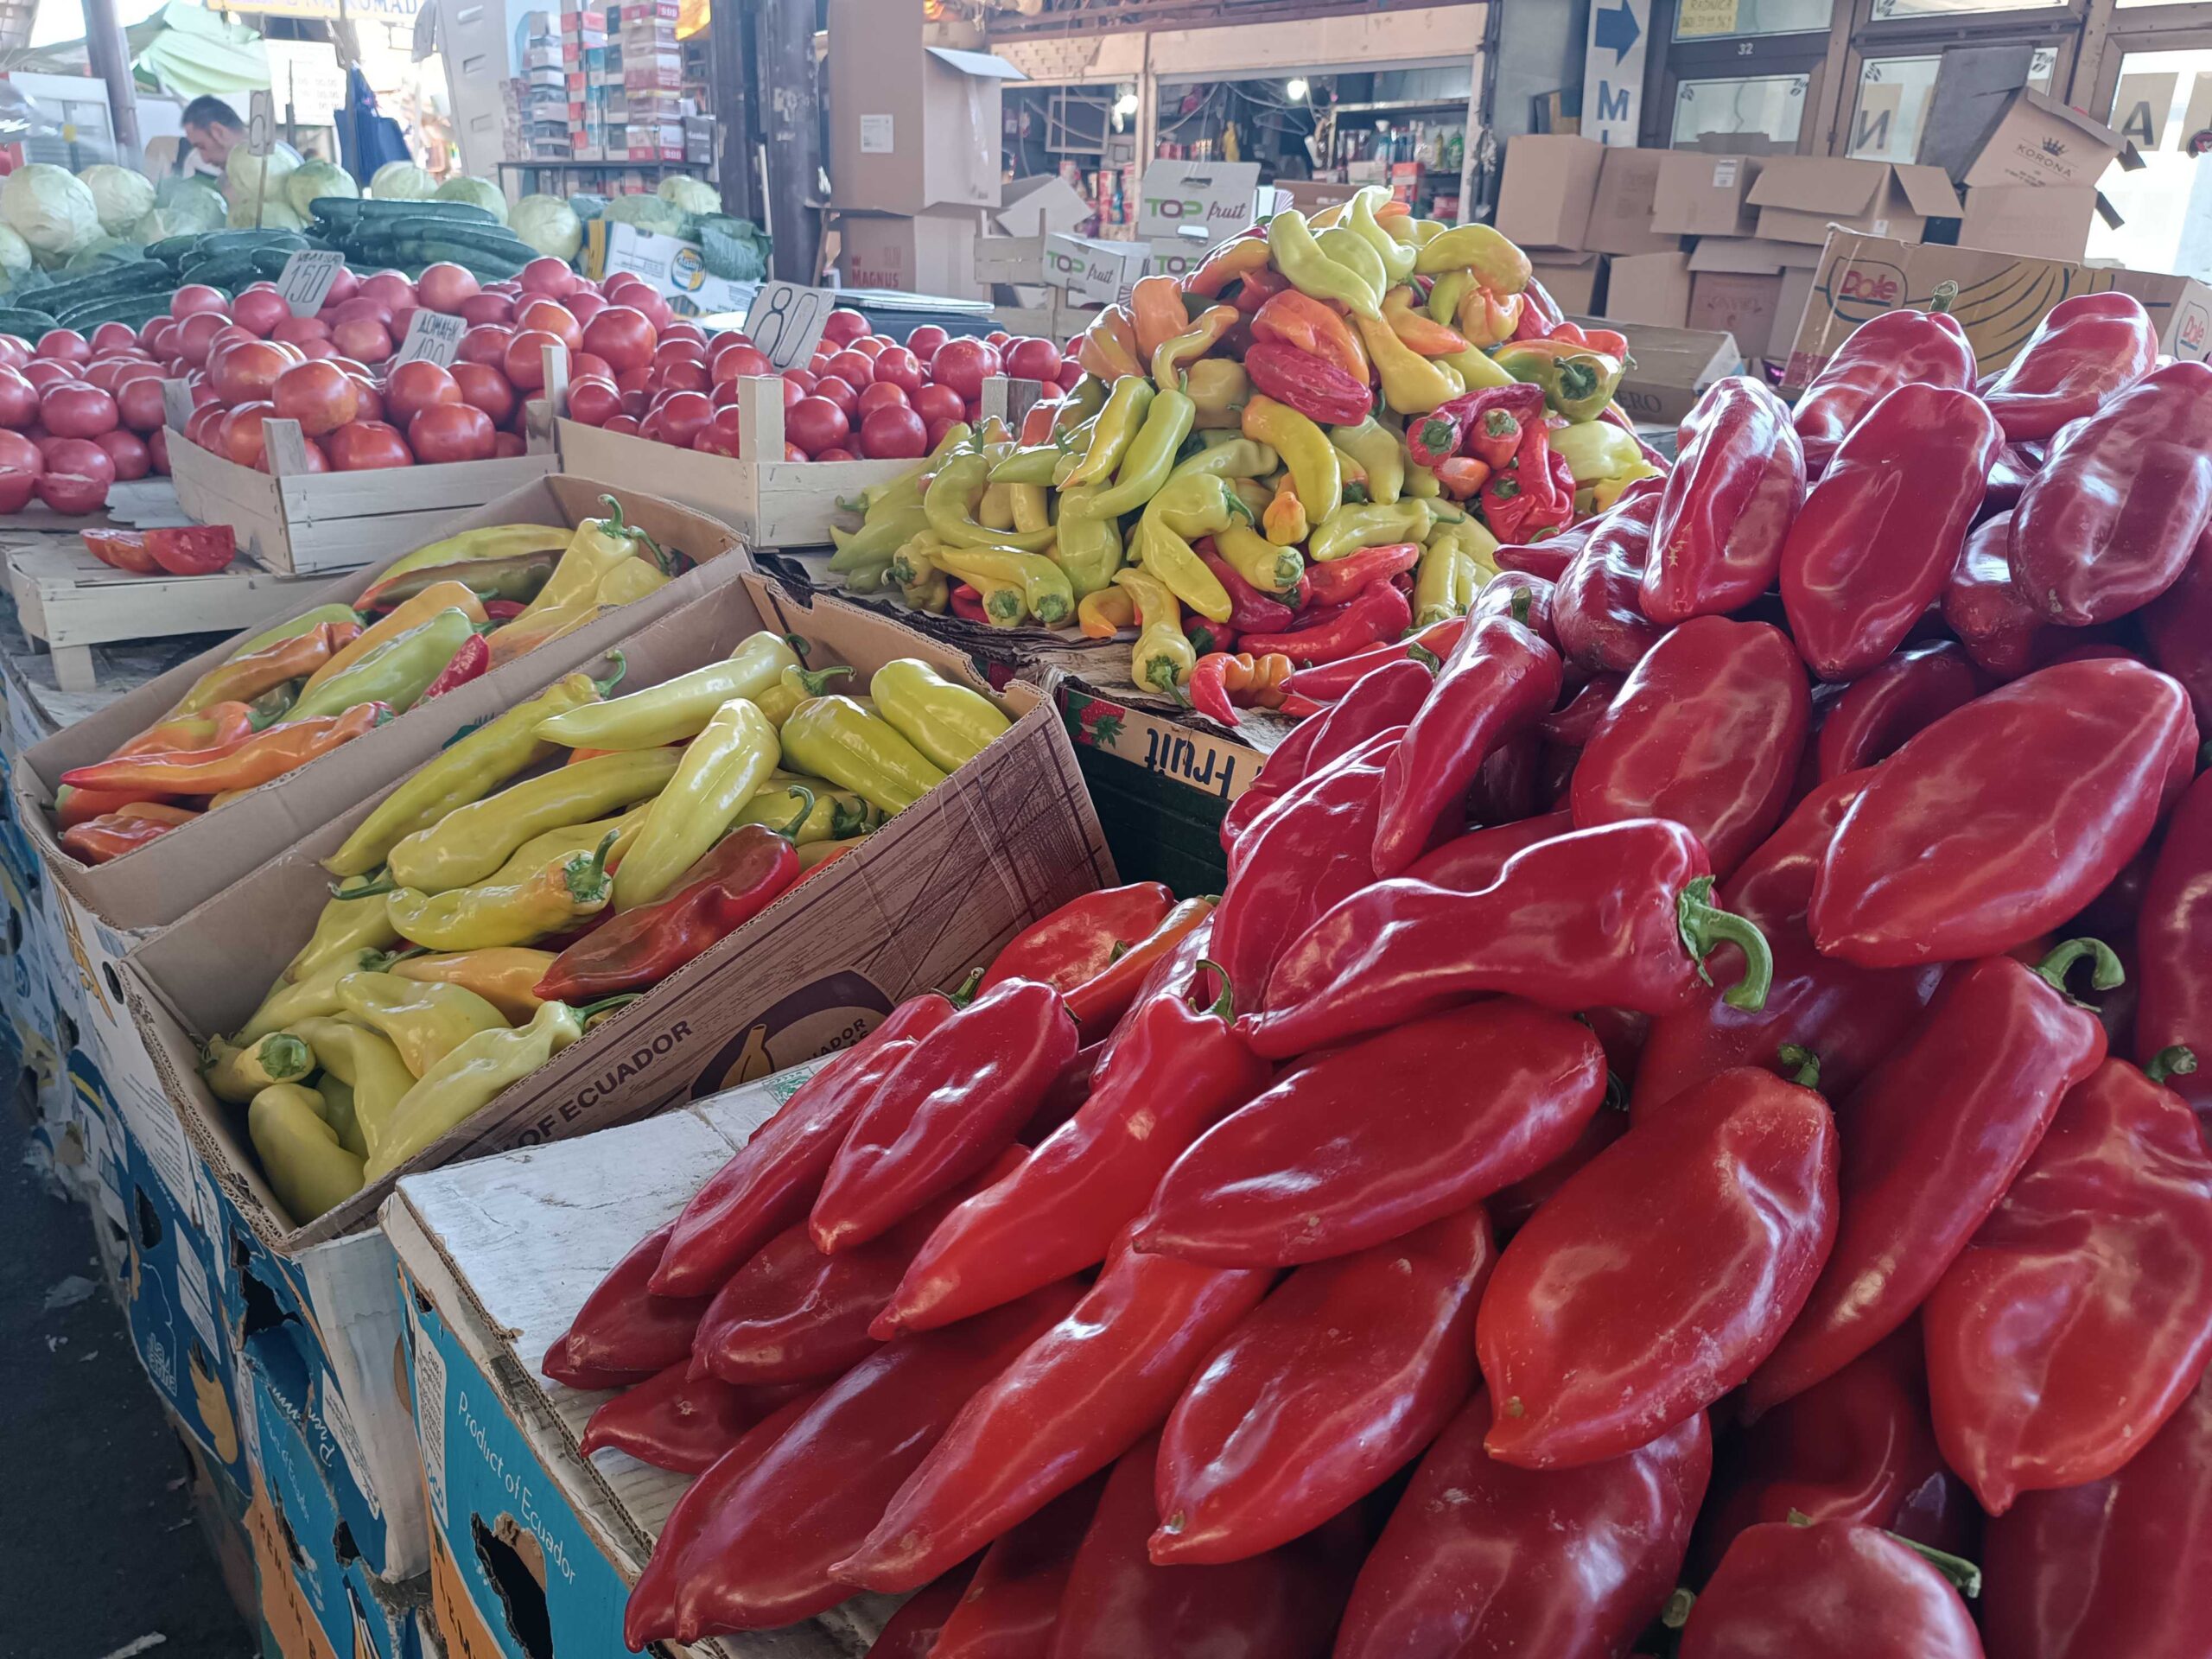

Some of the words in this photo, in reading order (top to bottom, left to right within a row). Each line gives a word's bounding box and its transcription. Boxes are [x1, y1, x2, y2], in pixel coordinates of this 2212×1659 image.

[1737, 43, 1753, 55] 32
[2017, 144, 2071, 177] KORONA
[1144, 198, 1203, 219] TOP
[1206, 200, 1247, 221] fruit
[283, 264, 332, 303] 150
[851, 270, 899, 288] MAGNUS
[1046, 251, 1085, 274] TOP
[1086, 263, 1115, 284] fruit
[1840, 270, 1898, 300] Dole
[753, 287, 819, 369] 80
[1144, 728, 1236, 798] Fruit
[812, 1018, 867, 1058] ADOR
[518, 1114, 556, 1146] OF
[558, 1020, 693, 1122] ECUADOR
[458, 1390, 504, 1478] Product
[505, 1473, 521, 1500] of
[521, 1486, 576, 1586] Ecuador
